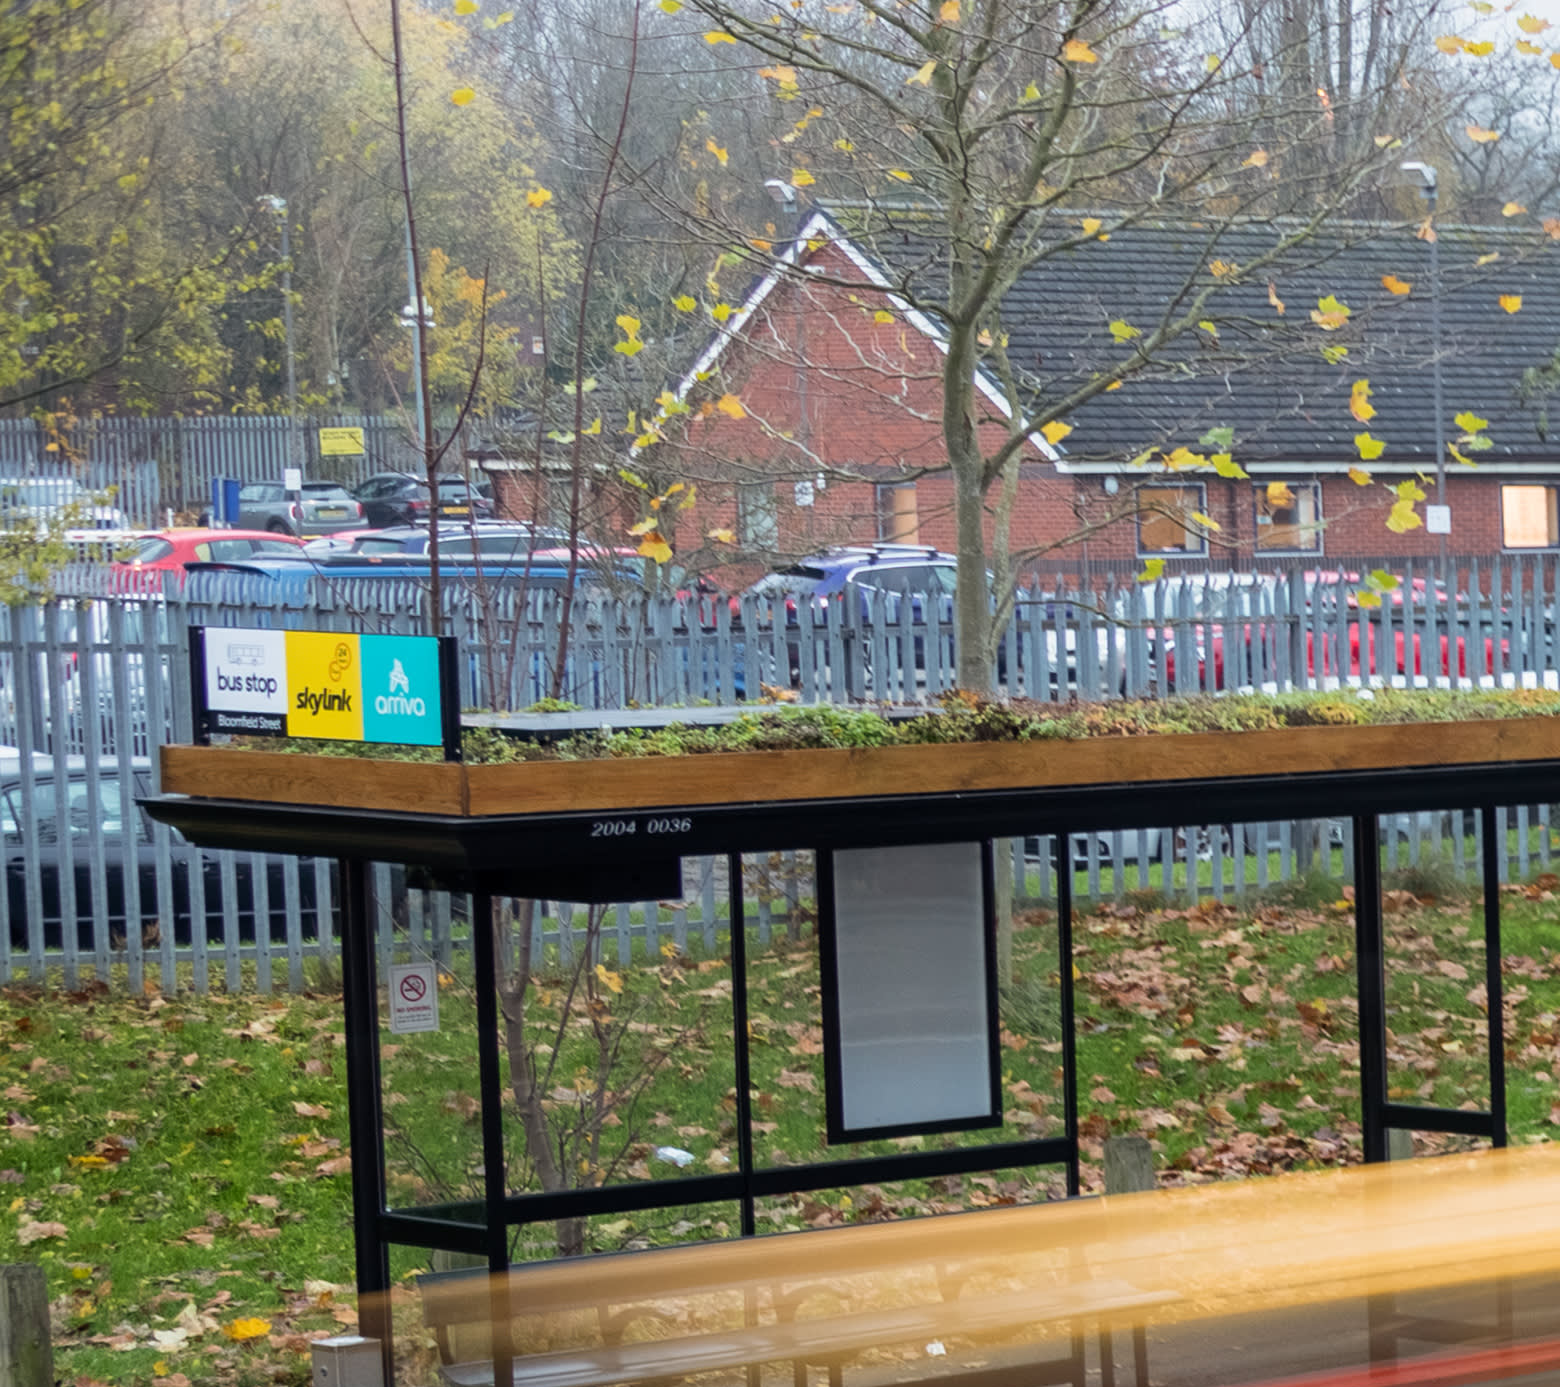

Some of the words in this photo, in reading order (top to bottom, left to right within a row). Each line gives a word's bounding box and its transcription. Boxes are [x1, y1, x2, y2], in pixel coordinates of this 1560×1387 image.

[217, 666, 243, 692] bus
[245, 672, 277, 699] stop
[296, 687, 353, 716] skylink
[374, 692, 426, 717] arriva
[218, 714, 258, 729] Bloomfield
[258, 716, 282, 731] Street
[591, 820, 637, 837] 2004
[647, 817, 692, 834] 0036
